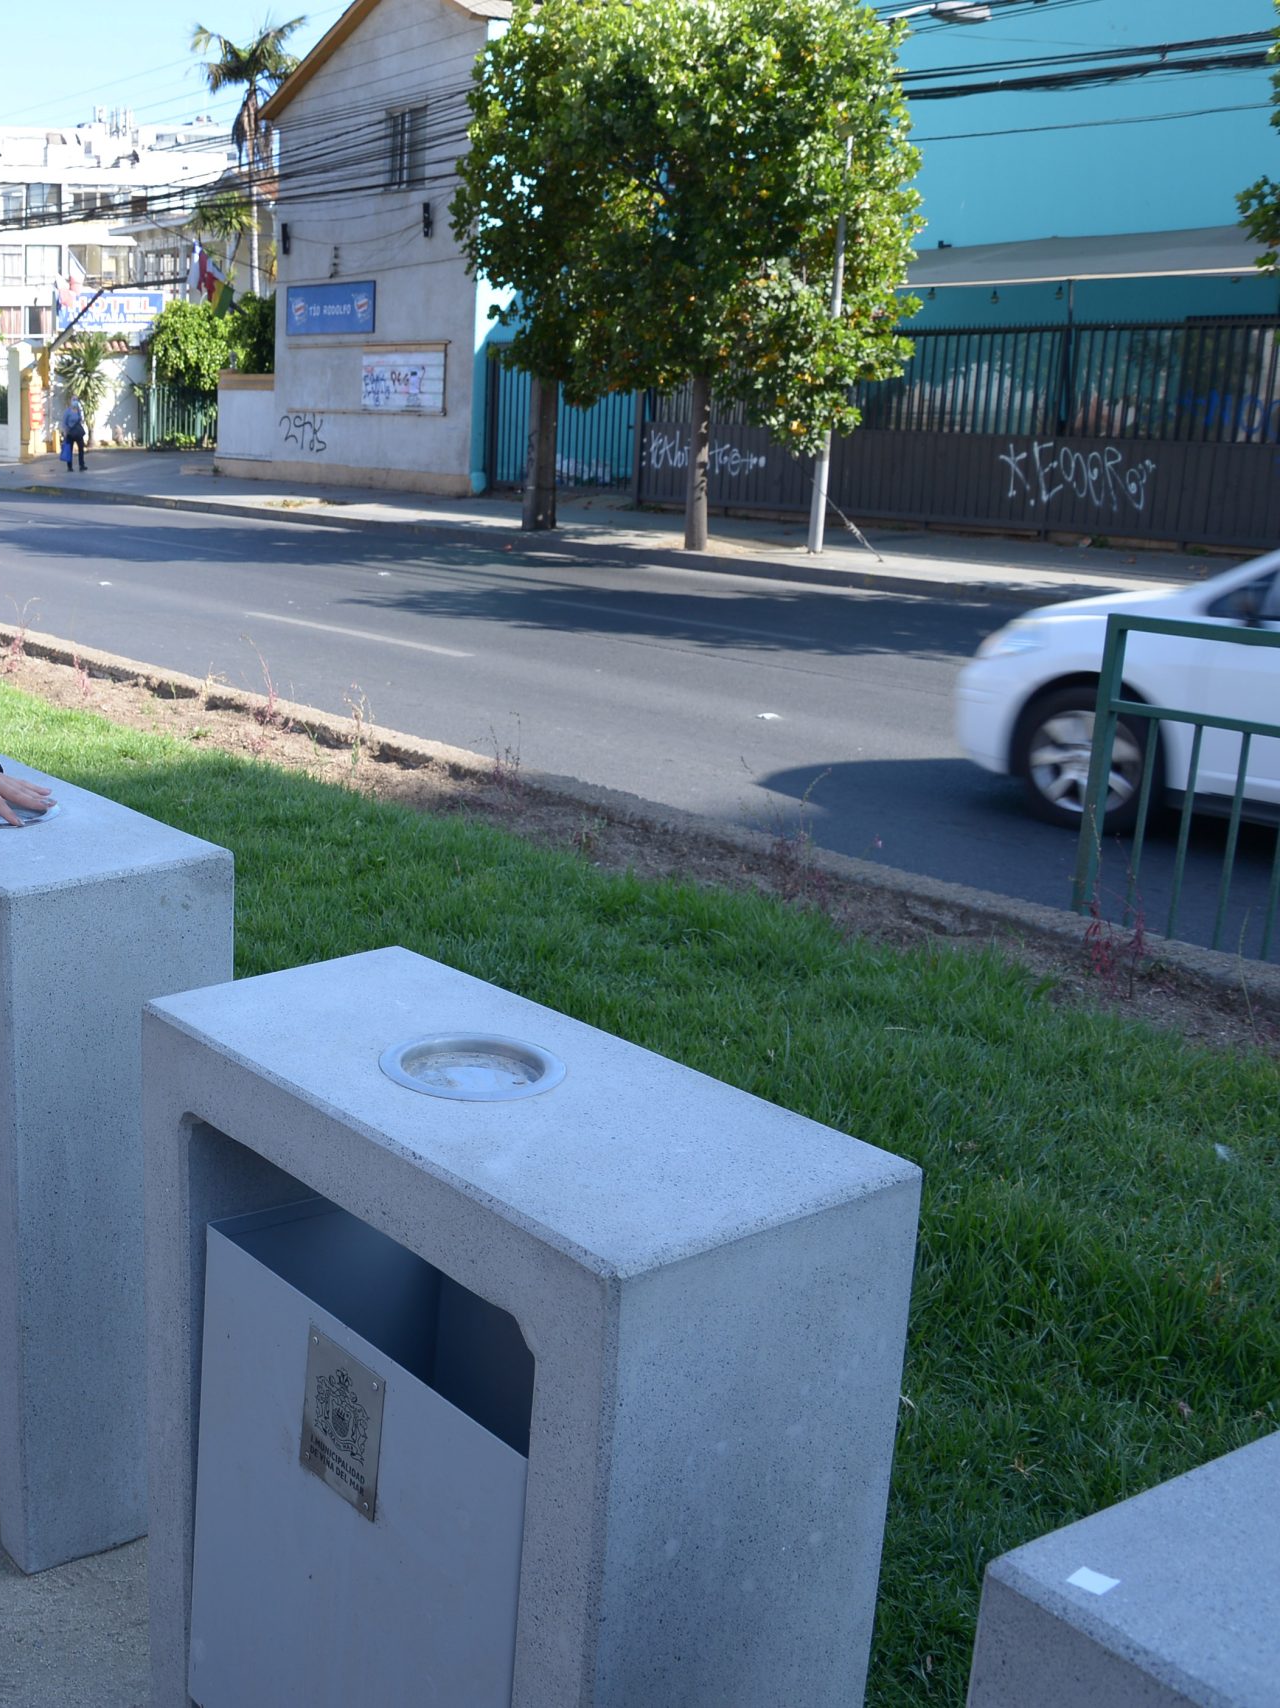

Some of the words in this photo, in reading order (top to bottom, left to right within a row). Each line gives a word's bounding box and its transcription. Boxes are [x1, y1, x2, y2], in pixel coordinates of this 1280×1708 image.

[68, 295, 157, 314] HOTEL
[322, 303, 352, 316] RODOLFO
[310, 1444, 320, 1458] DE
[319, 1452, 335, 1473] VIÑA
[335, 1466, 349, 1484] DEL
[349, 1478, 365, 1497] MAR
[315, 1436, 366, 1485] MUNICIPALIDAD
